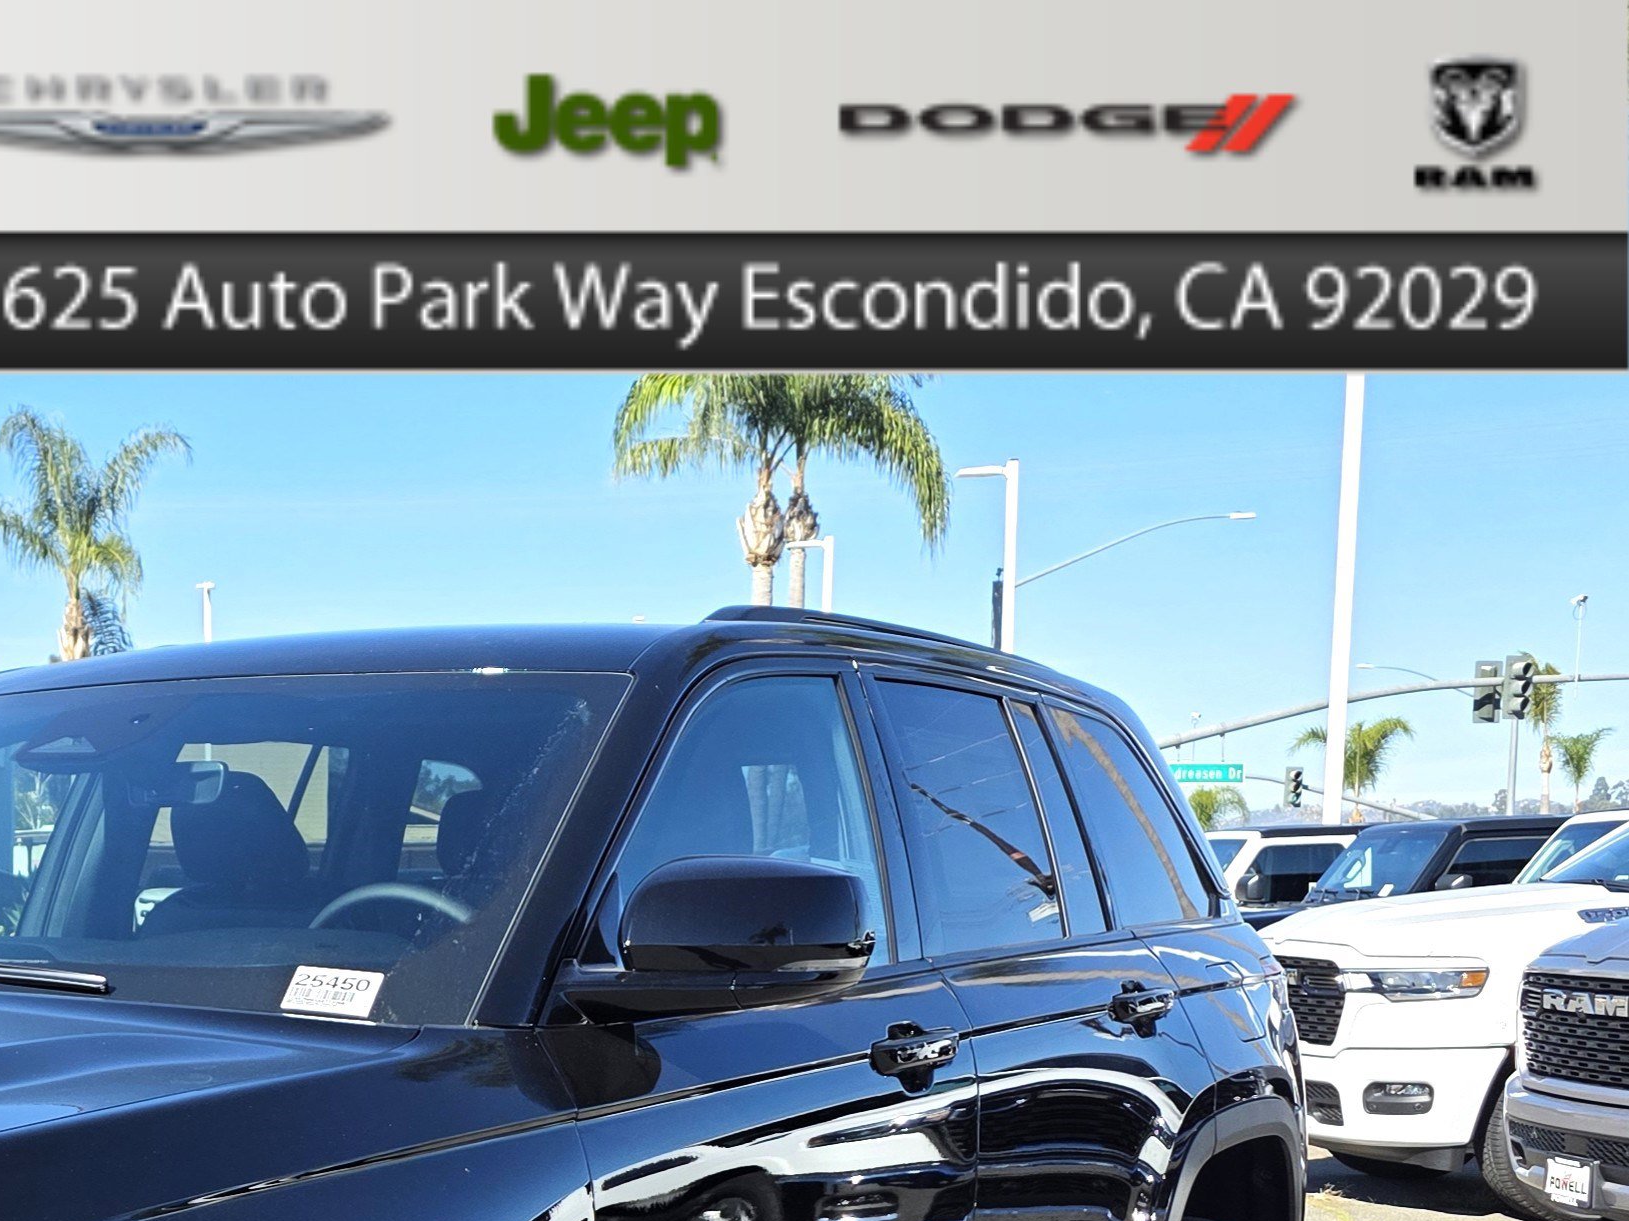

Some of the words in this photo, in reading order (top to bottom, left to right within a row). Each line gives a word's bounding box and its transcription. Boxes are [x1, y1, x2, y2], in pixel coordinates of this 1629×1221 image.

[1174, 766, 1222, 780] dreasen
[1228, 767, 1242, 780] Dr
[294, 973, 371, 992] 25450
[1542, 988, 1629, 1018] RAM
